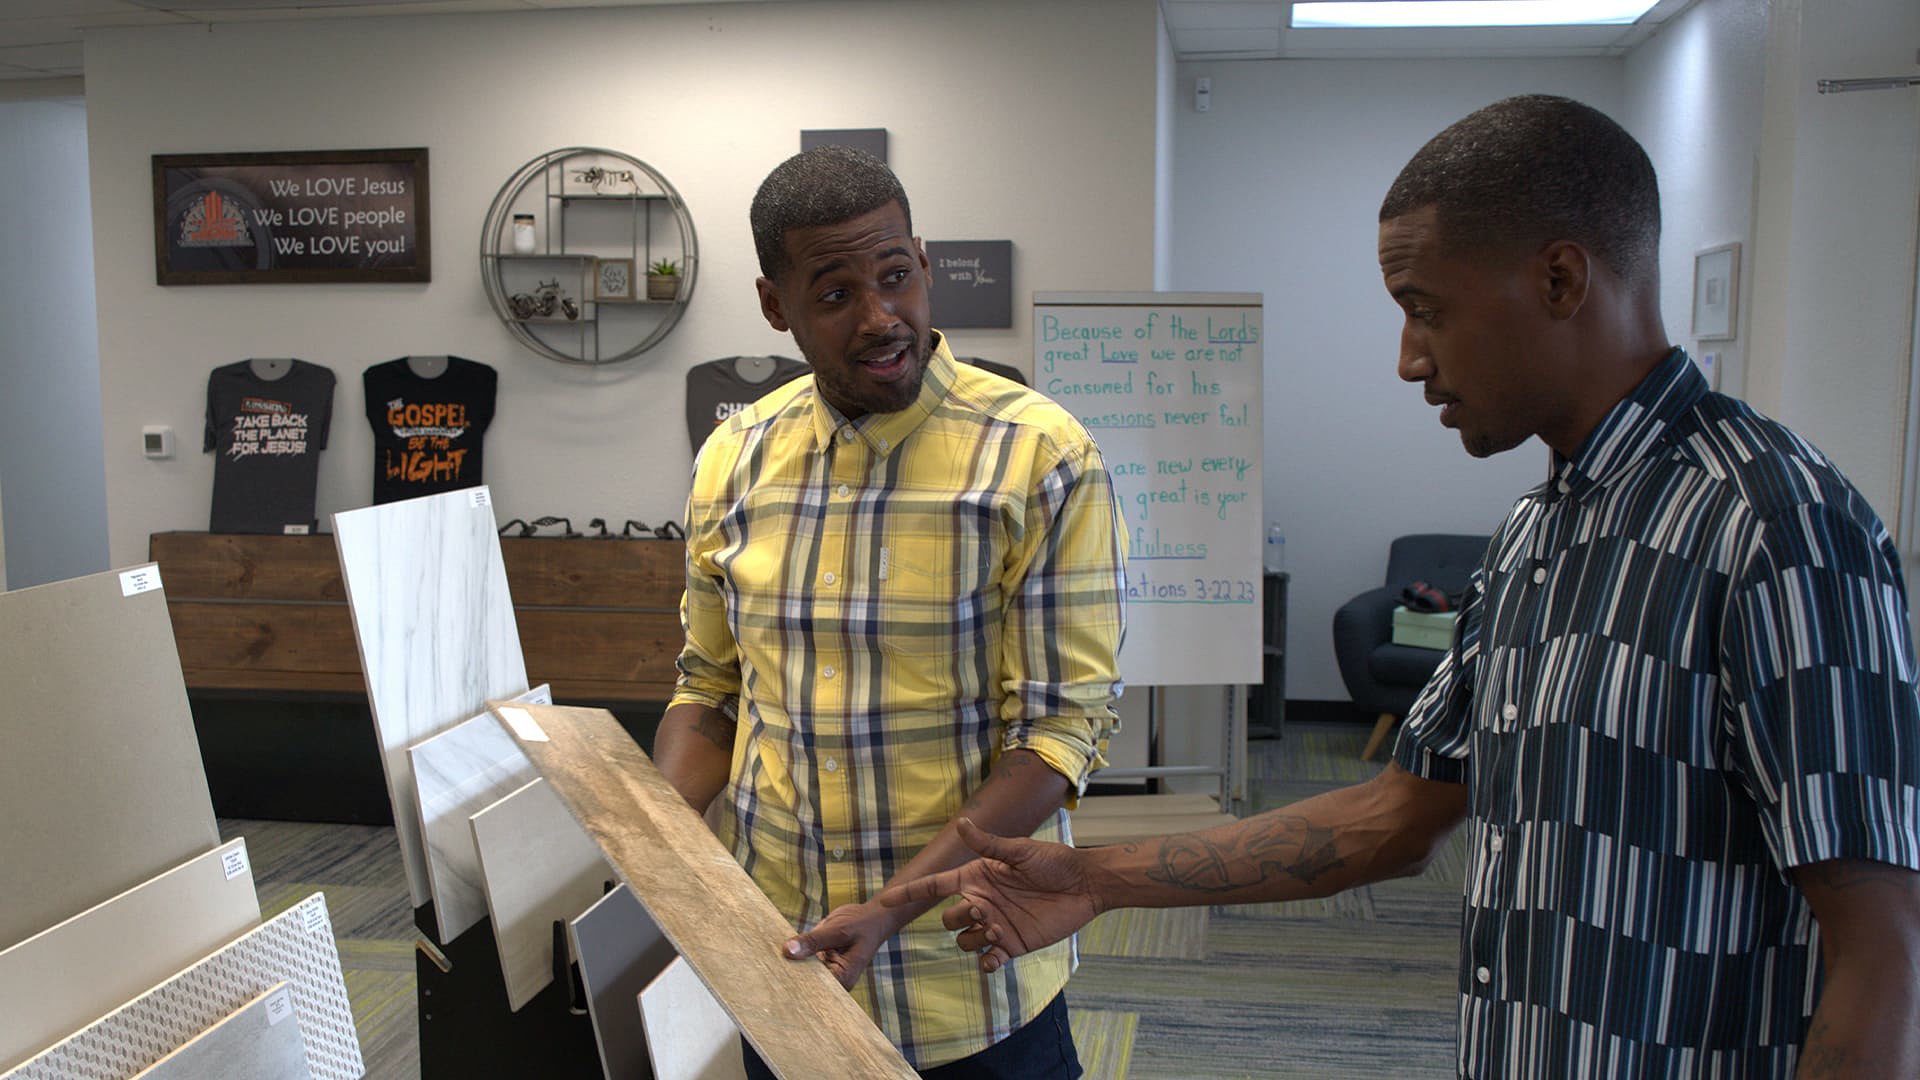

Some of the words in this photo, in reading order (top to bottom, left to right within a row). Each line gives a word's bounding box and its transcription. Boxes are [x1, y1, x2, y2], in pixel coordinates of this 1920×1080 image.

[270, 179, 300, 197] We
[306, 178, 355, 196] LOVE
[361, 177, 404, 195] Jesus
[253, 209, 283, 226] We
[289, 207, 338, 226] LOVE
[344, 206, 405, 229] people
[274, 238, 304, 255] We
[311, 236, 359, 254] LOVE
[365, 235, 405, 257] you!
[946, 257, 981, 268] belong
[1042, 314, 1122, 342] Because
[1134, 313, 1159, 340] of
[1170, 314, 1199, 340] the
[1044, 342, 1088, 373] great
[1100, 341, 1138, 361] Love
[1151, 350, 1176, 361] we
[1185, 349, 1213, 362] are
[1220, 344, 1243, 363] not
[1146, 371, 1175, 395] for
[1192, 371, 1222, 396] his
[235, 415, 270, 428] TAKE
[271, 413, 308, 427] BACK
[387, 403, 470, 427] GOSPEL
[1164, 411, 1209, 425] never
[1220, 403, 1247, 426] fail
[234, 429, 258, 441] THE
[259, 427, 307, 440] PLANET
[231, 442, 259, 456] FOR
[260, 441, 307, 455] JESUS!
[385, 448, 469, 482] LIGHT
[1114, 462, 1146, 475] are
[1158, 458, 1192, 474] new
[1201, 456, 1252, 480] every
[1136, 479, 1186, 520] great
[1195, 489, 1210, 505] is
[1217, 492, 1248, 520] your
[1129, 527, 1208, 556] fulness
[1126, 573, 1186, 598] ations
